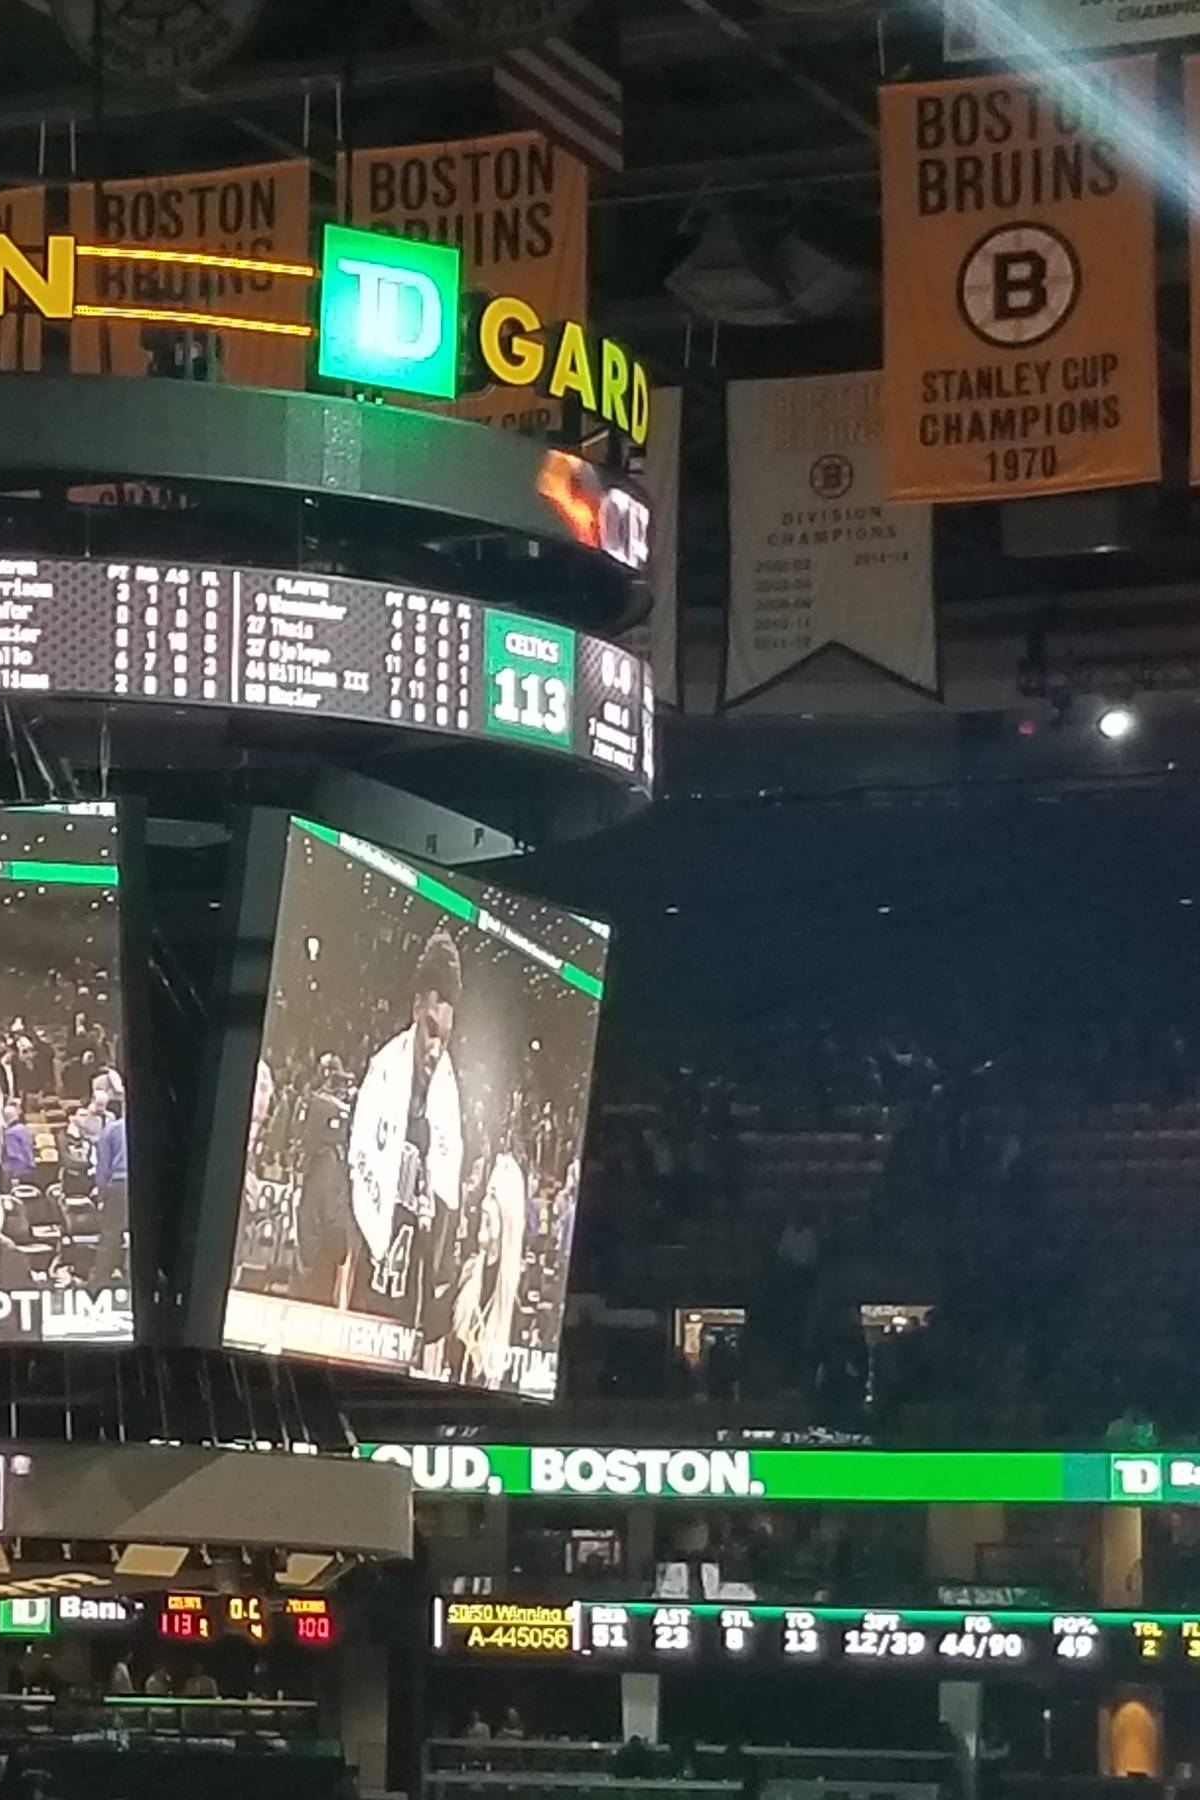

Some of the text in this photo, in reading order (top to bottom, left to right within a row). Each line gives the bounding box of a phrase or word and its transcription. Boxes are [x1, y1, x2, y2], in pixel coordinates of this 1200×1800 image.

[369, 144, 554, 214] BOSTON
[918, 141, 1118, 217] BRUINS
[97, 178, 275, 243] BOSTON
[992, 250, 1047, 320] B
[337, 257, 441, 362] TD
[480, 297, 648, 445] GARD
[921, 353, 1119, 403] STANLEY CUP
[919, 396, 1120, 447] CHAMPIONS
[986, 444, 1057, 483] 1970
[781, 506, 882, 526] DIVISION
[767, 524, 896, 546] CHAMPIONS
[117, 583, 130, 602] 3
[147, 585, 158, 604] 1
[178, 586, 188, 606] 1
[146, 630, 157, 650] 1
[460, 622, 469, 640] 1
[505, 632, 560, 663] CELTICS
[144, 652, 157, 671] 7
[385, 654, 401, 674] 11
[460, 666, 468, 685] 1
[343, 670, 369, 693] III
[408, 680, 424, 699] 11
[460, 687, 468, 706] 1
[494, 668, 566, 733] 113
[531, 1449, 764, 1497] BOSTON.
[1114, 1460, 1161, 1494] TD
[161, 1614, 192, 1635] 113
[299, 1617, 330, 1638] 100
[653, 1608, 691, 1626] AST
[720, 1609, 754, 1628] STL
[784, 1611, 816, 1629] TO
[964, 1616, 992, 1634] FG
[1053, 1616, 1098, 1635] FG%
[468, 1625, 570, 1649] A-445056
[655, 1625, 689, 1649] 23
[784, 1629, 818, 1652] 13
[844, 1630, 926, 1656] 12/39
[939, 1632, 1022, 1659] 44/90
[1056, 1635, 1093, 1658] 49
[1142, 1639, 1156, 1657] 2
